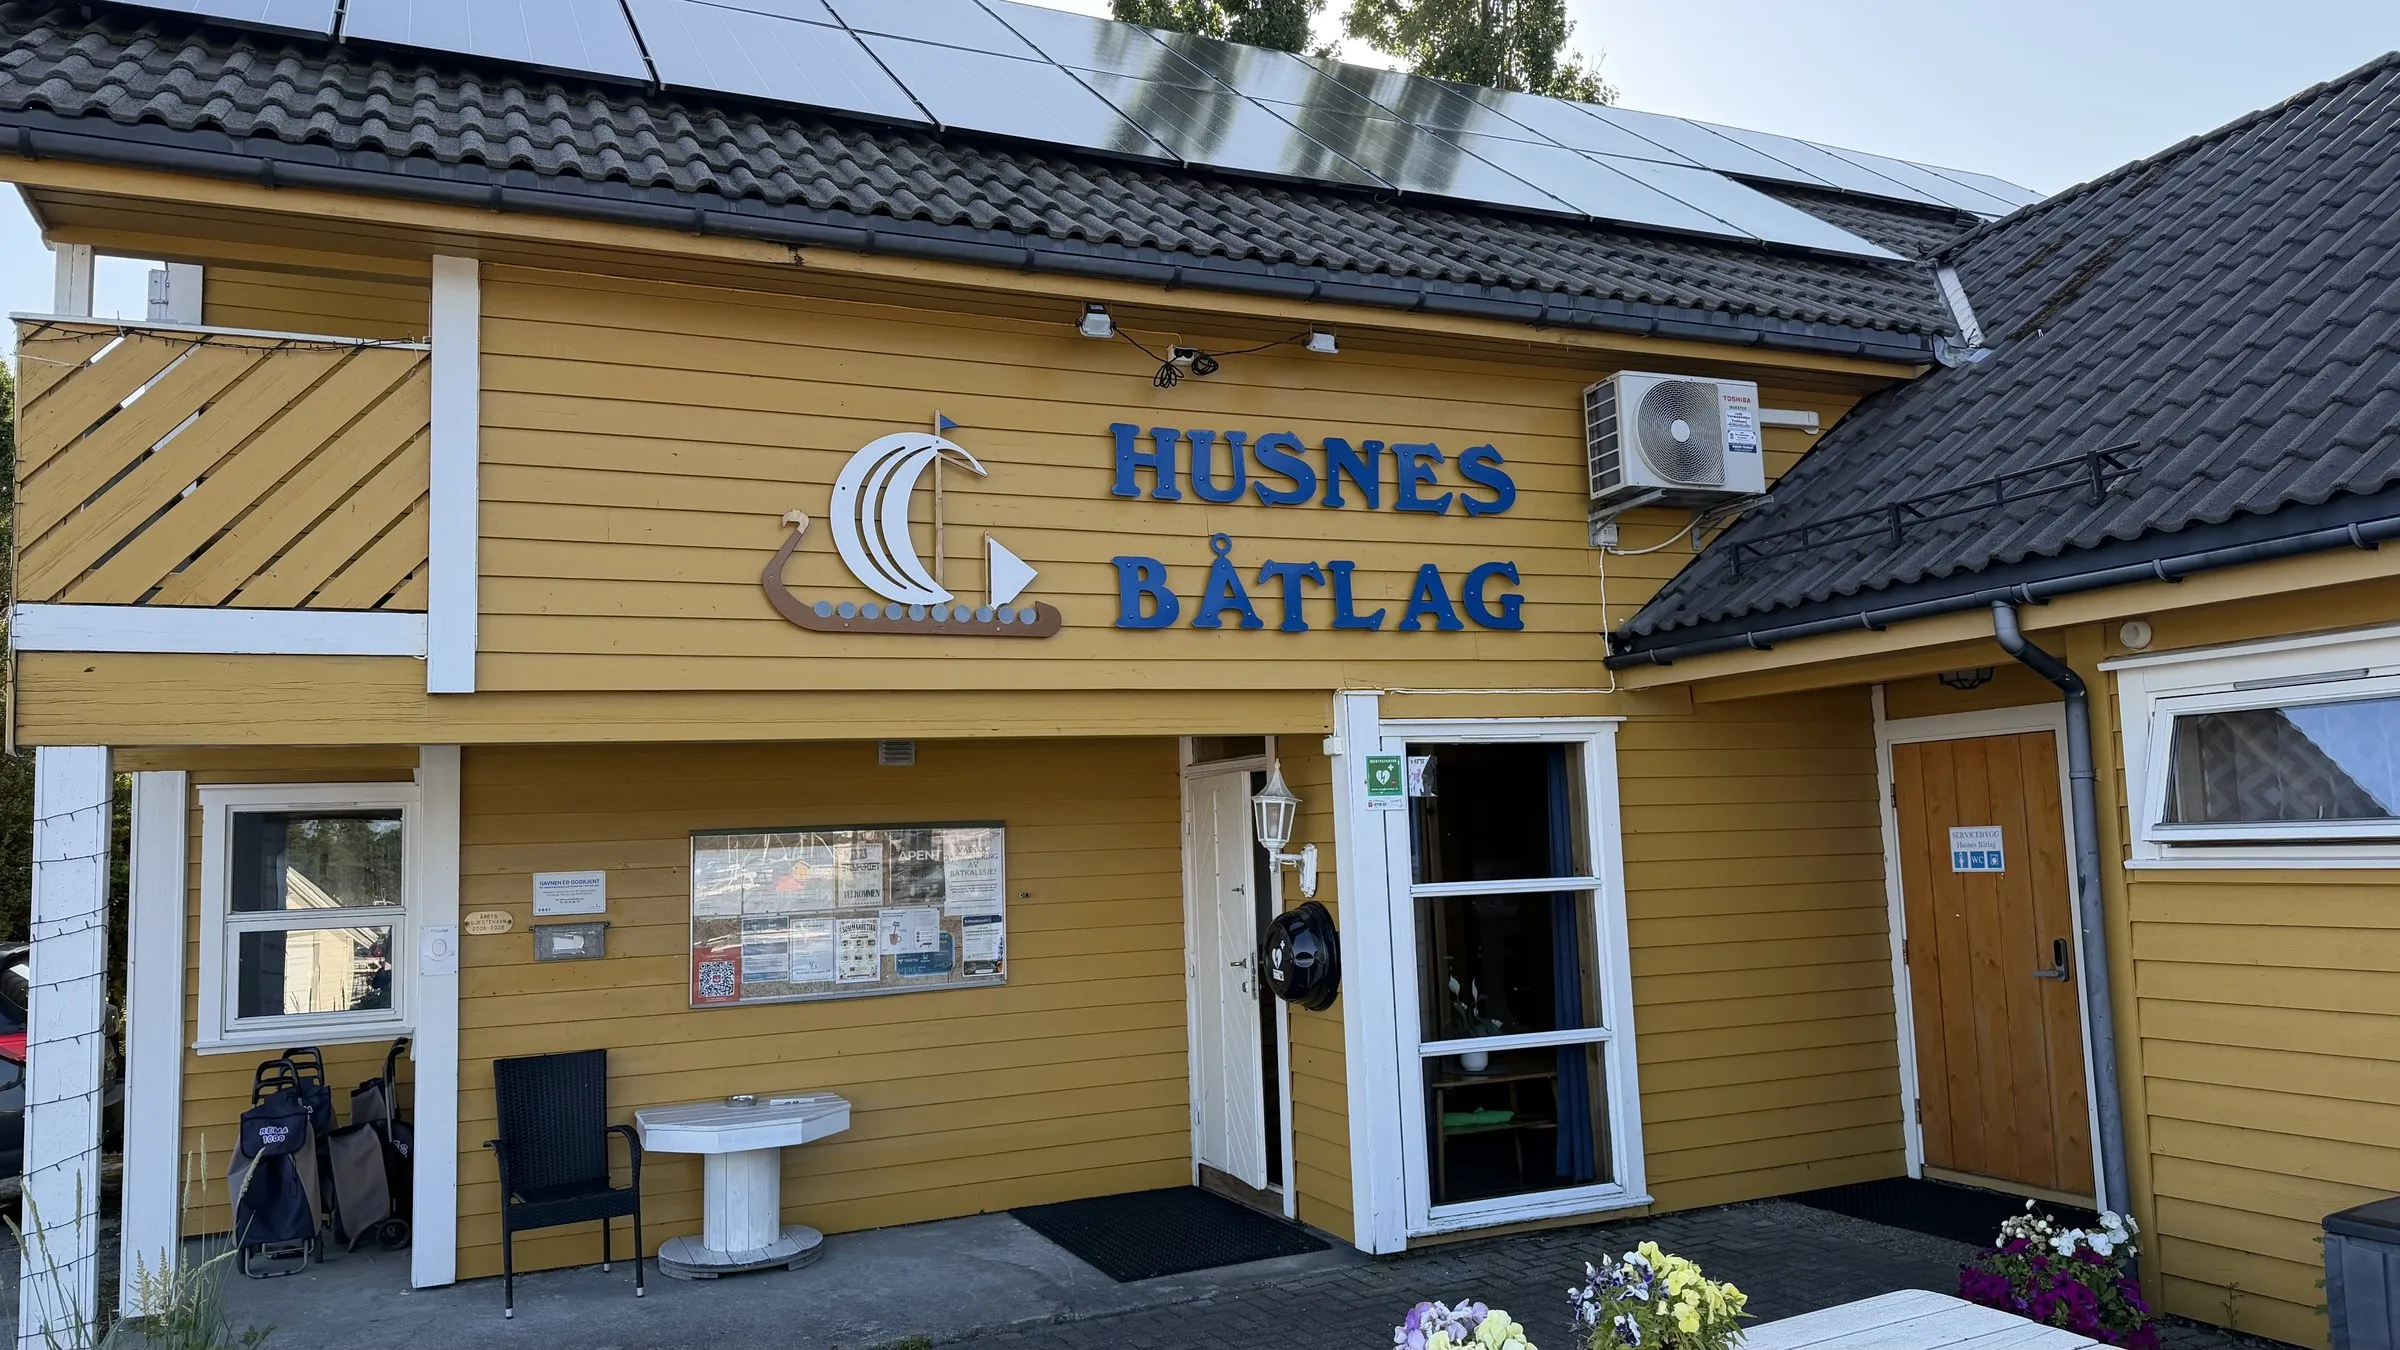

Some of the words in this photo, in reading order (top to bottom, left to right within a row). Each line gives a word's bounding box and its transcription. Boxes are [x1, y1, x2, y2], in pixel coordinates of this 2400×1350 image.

[1723, 395, 1751, 403] TOSHIBA
[1109, 422, 1516, 516] HUSNES
[1111, 532, 1525, 632] BÅTLAG
[1952, 830, 1999, 839] SERVICEBYGG
[898, 847, 942, 861] ÅPENT
[1971, 856, 1984, 864] WC
[844, 889, 880, 898] VELKOMMEN
[259, 1126, 289, 1135] REMA
[263, 1135, 286, 1143] 1000
